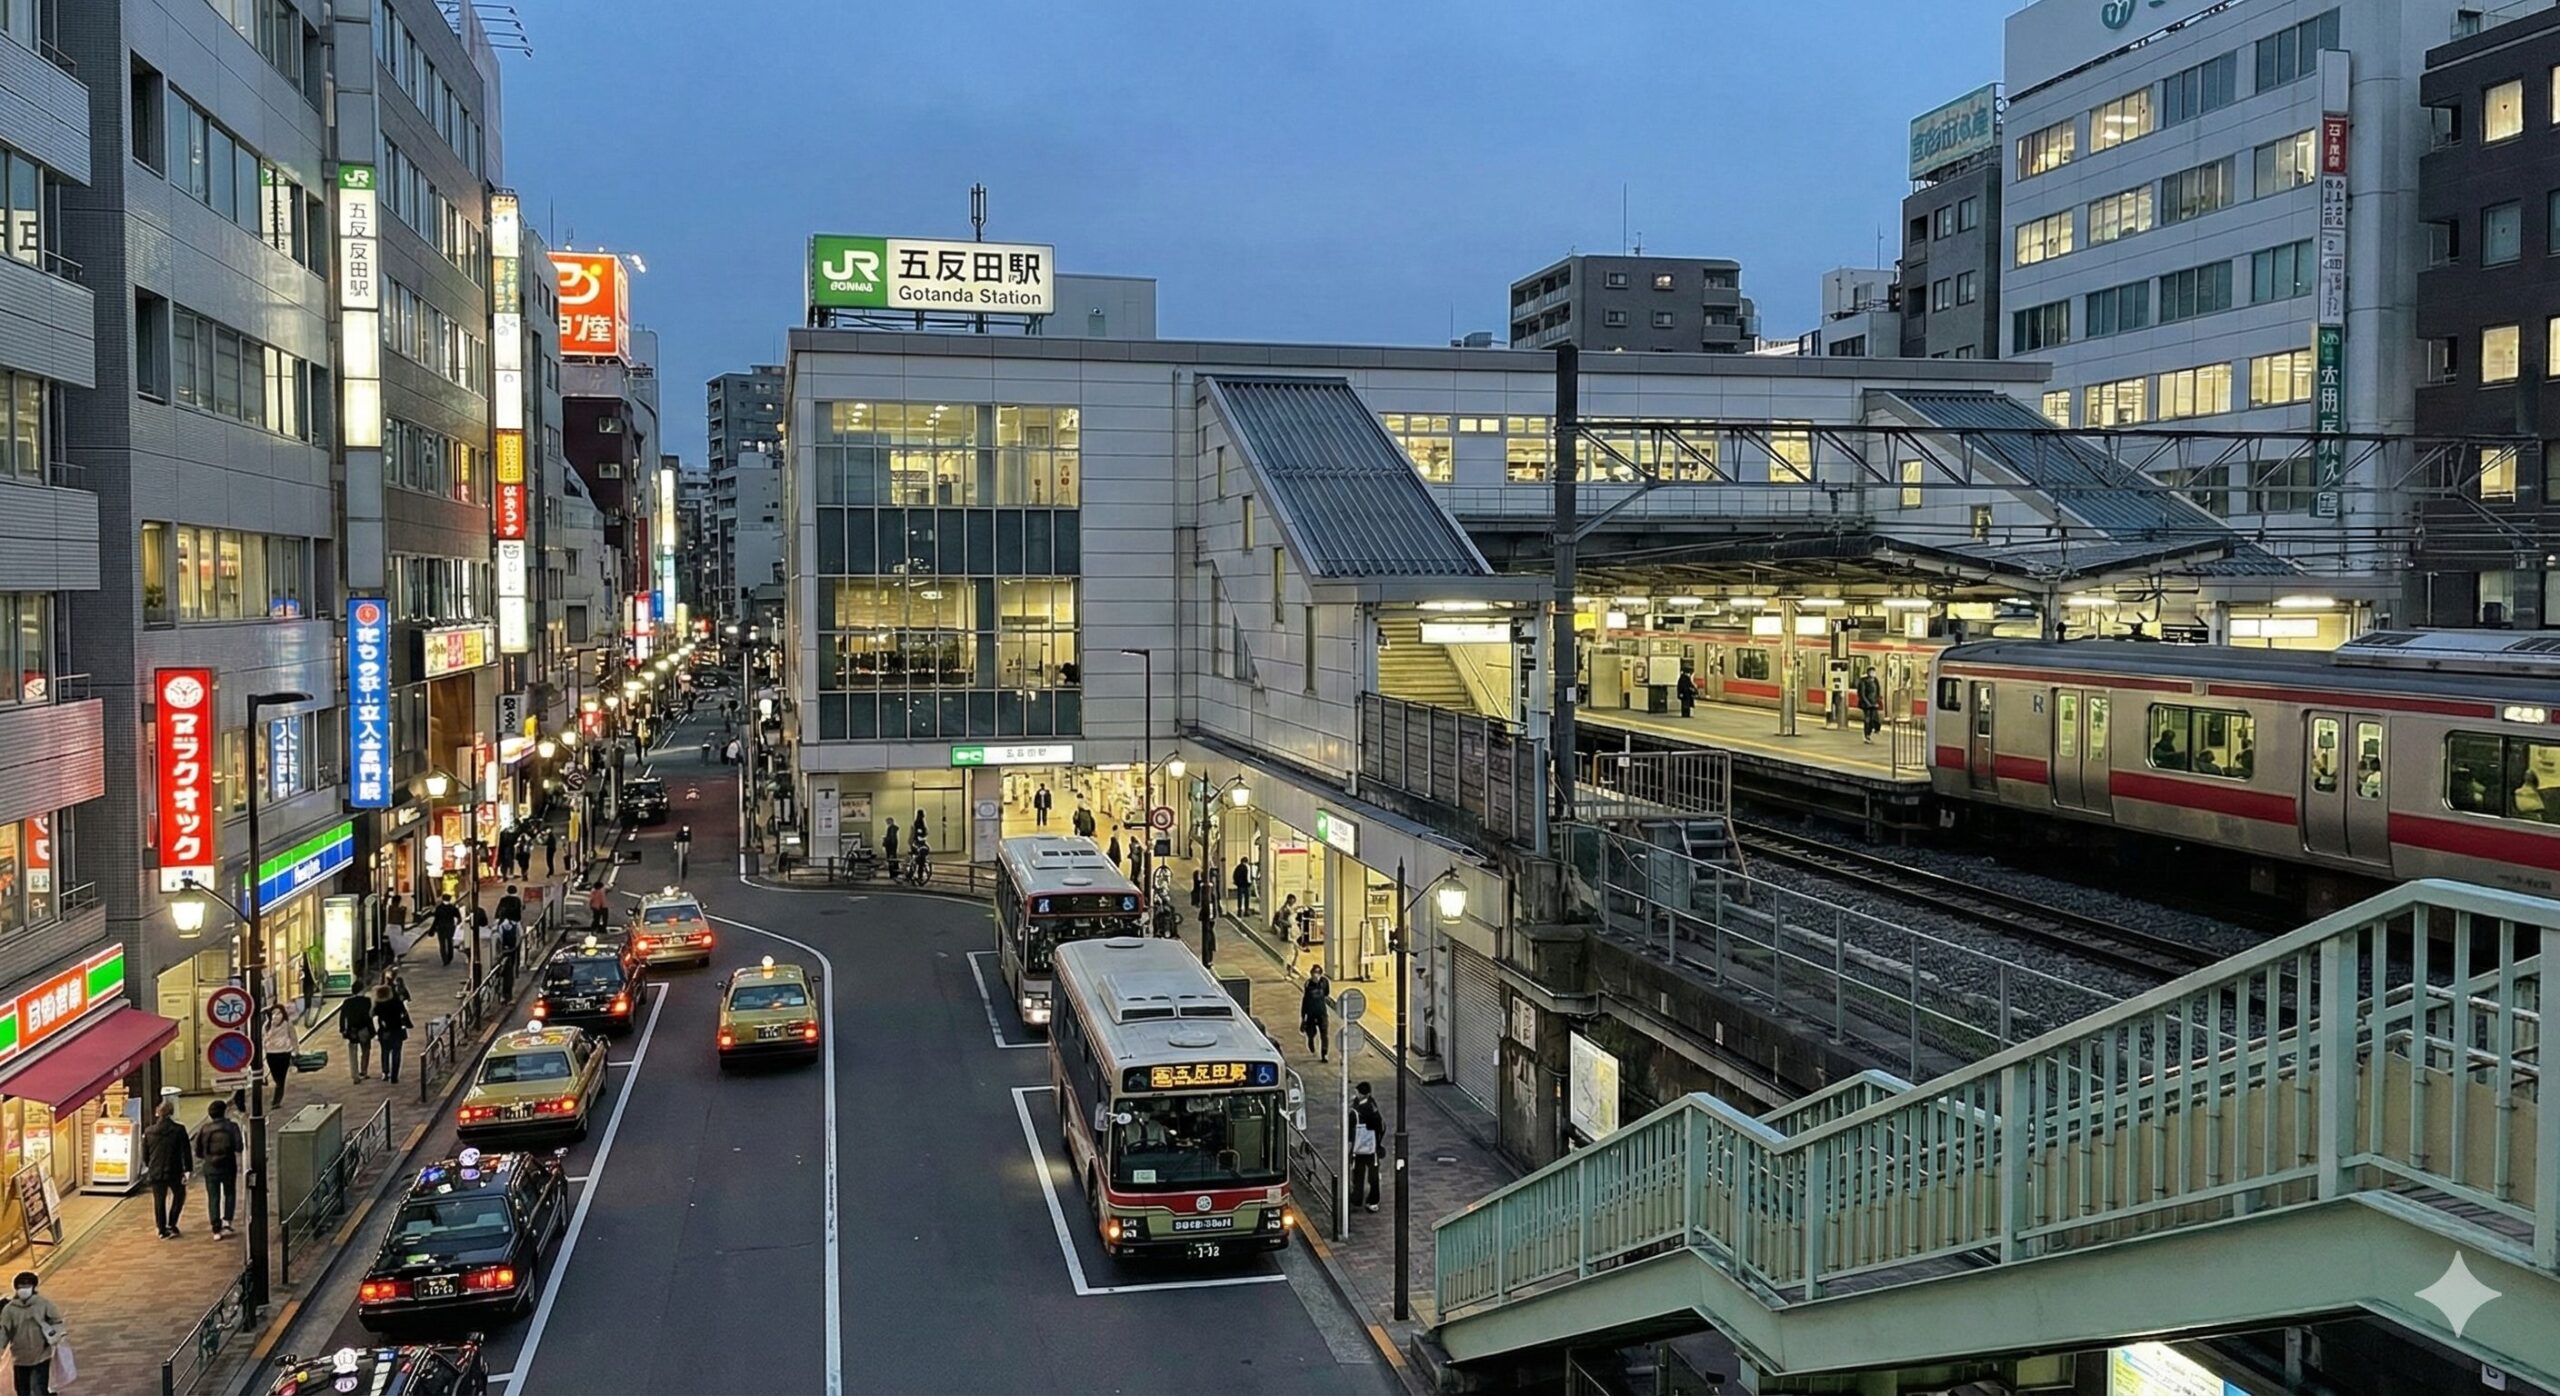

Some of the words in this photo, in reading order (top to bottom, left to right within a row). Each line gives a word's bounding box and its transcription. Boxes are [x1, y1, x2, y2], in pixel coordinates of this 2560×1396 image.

[344, 169, 370, 184] JR
[822, 250, 881, 282] JR
[898, 249, 1042, 285] 五反田駅
[898, 285, 974, 304] Gotanda
[980, 288, 1042, 306] Station
